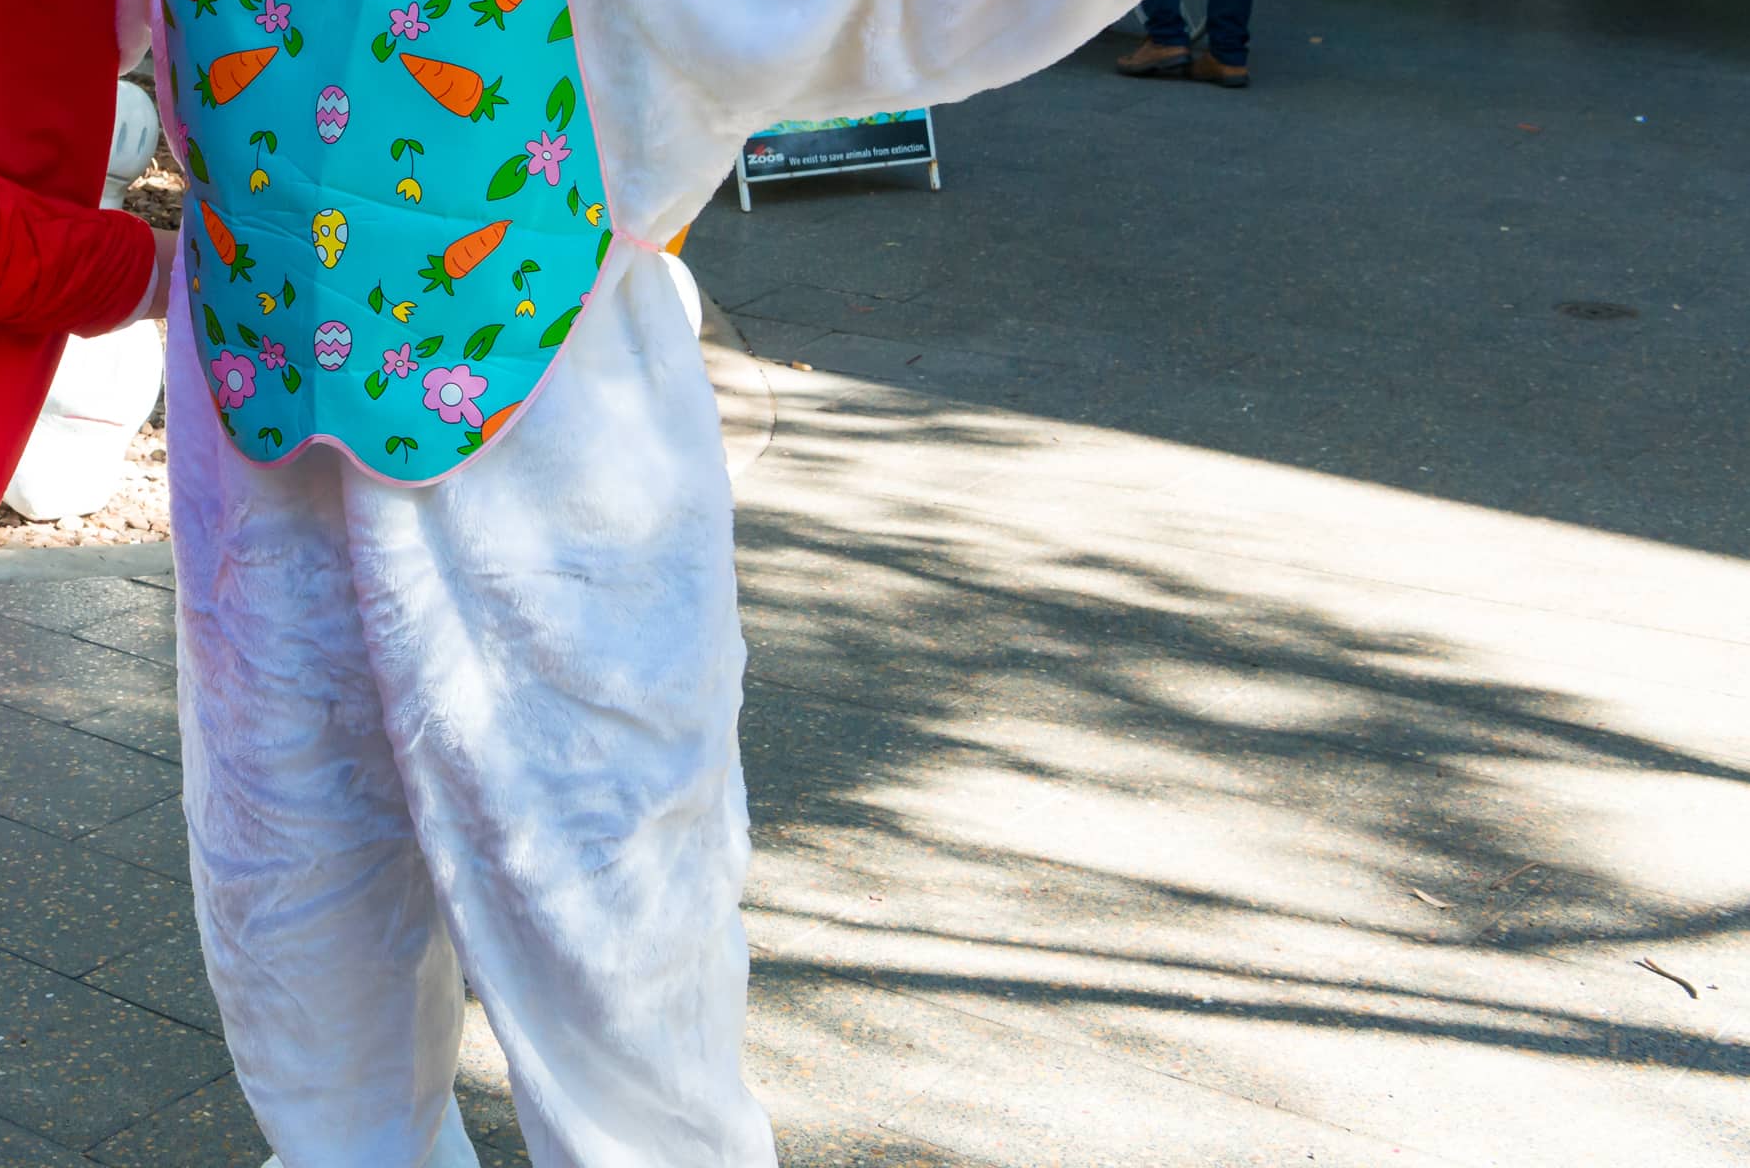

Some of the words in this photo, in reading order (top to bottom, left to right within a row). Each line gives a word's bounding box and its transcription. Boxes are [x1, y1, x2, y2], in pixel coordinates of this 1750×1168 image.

[789, 156, 801, 166] We
[802, 154, 819, 164] exist
[821, 153, 828, 163] to
[829, 153, 844, 162] save
[845, 148, 872, 160] animals
[873, 147, 890, 157] from
